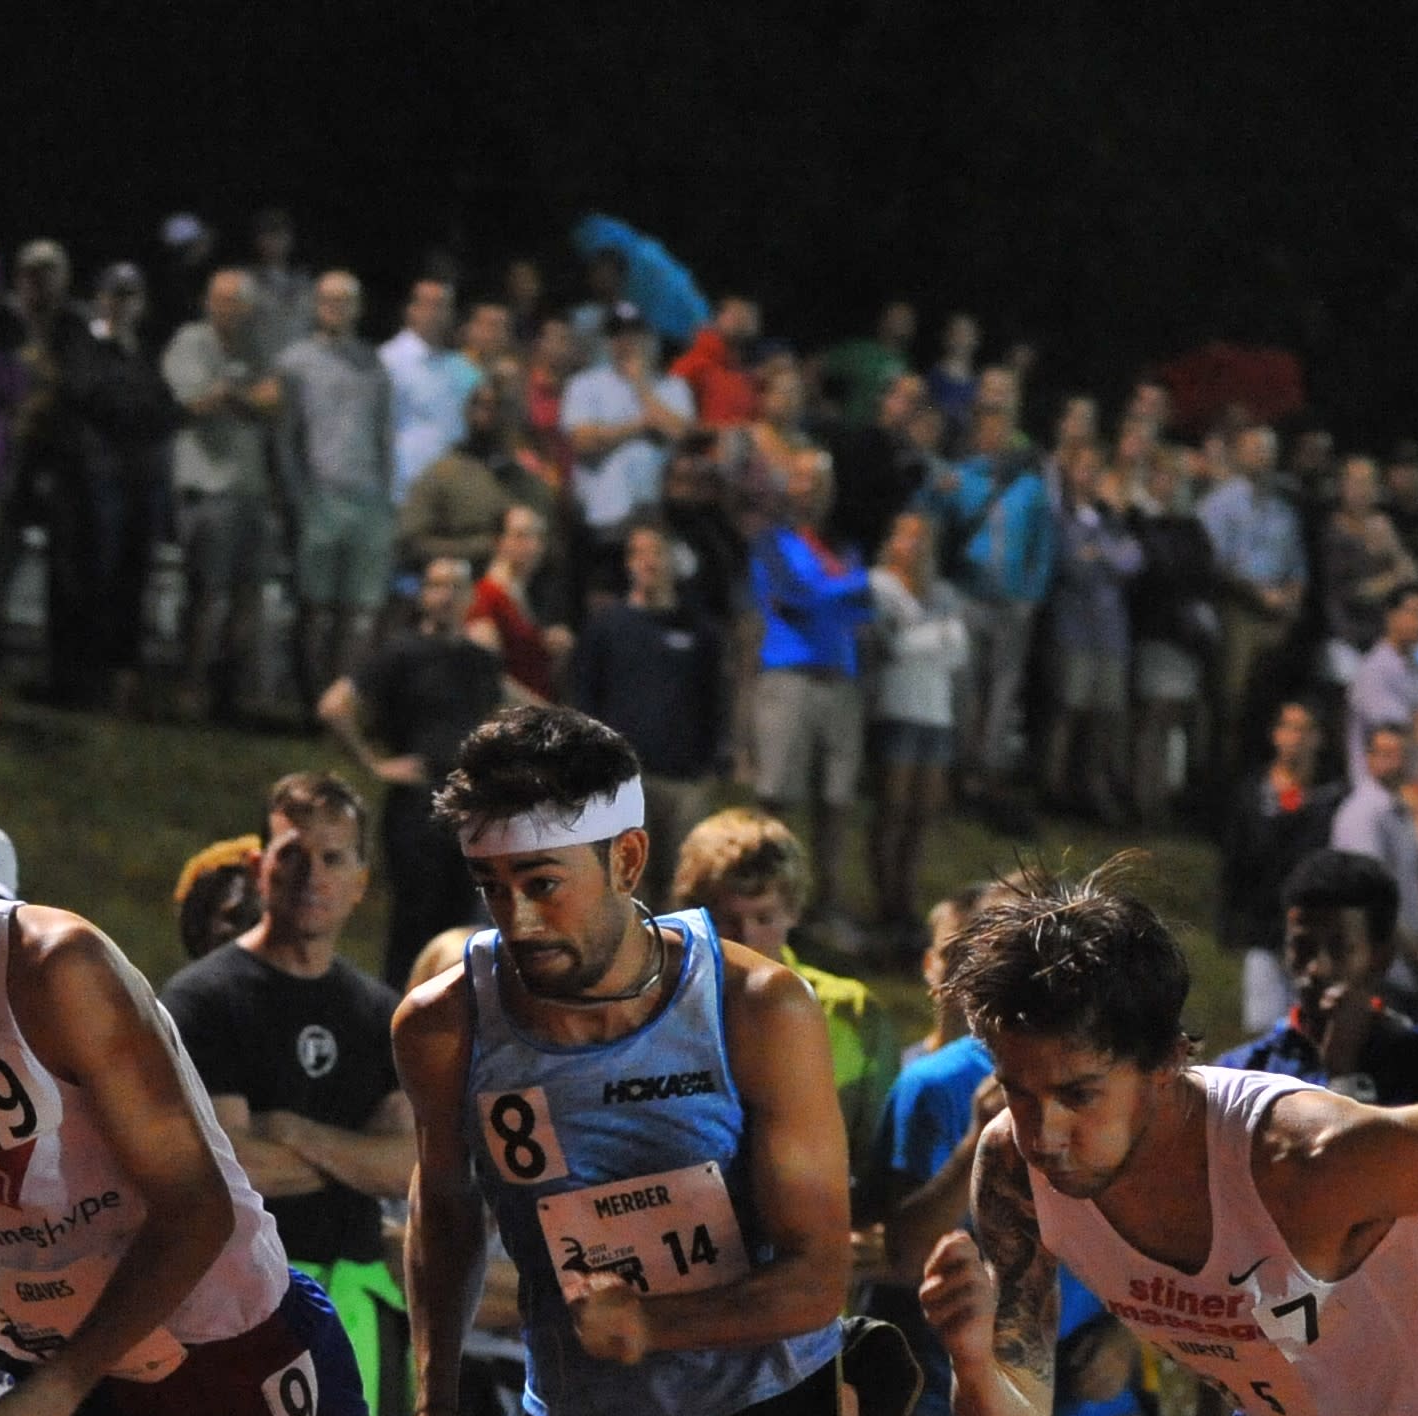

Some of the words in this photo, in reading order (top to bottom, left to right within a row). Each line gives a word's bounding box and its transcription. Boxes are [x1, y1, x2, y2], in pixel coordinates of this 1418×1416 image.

[603, 1074, 682, 1105] HOKA
[490, 1093, 546, 1180] 8
[593, 1185, 672, 1219] MERBER
[661, 1223, 719, 1276] 14
[15, 1278, 76, 1303] GRAVES
[1129, 1276, 1247, 1319] stiner
[1271, 1292, 1320, 1346] 7
[1249, 1380, 1287, 1416] 5
